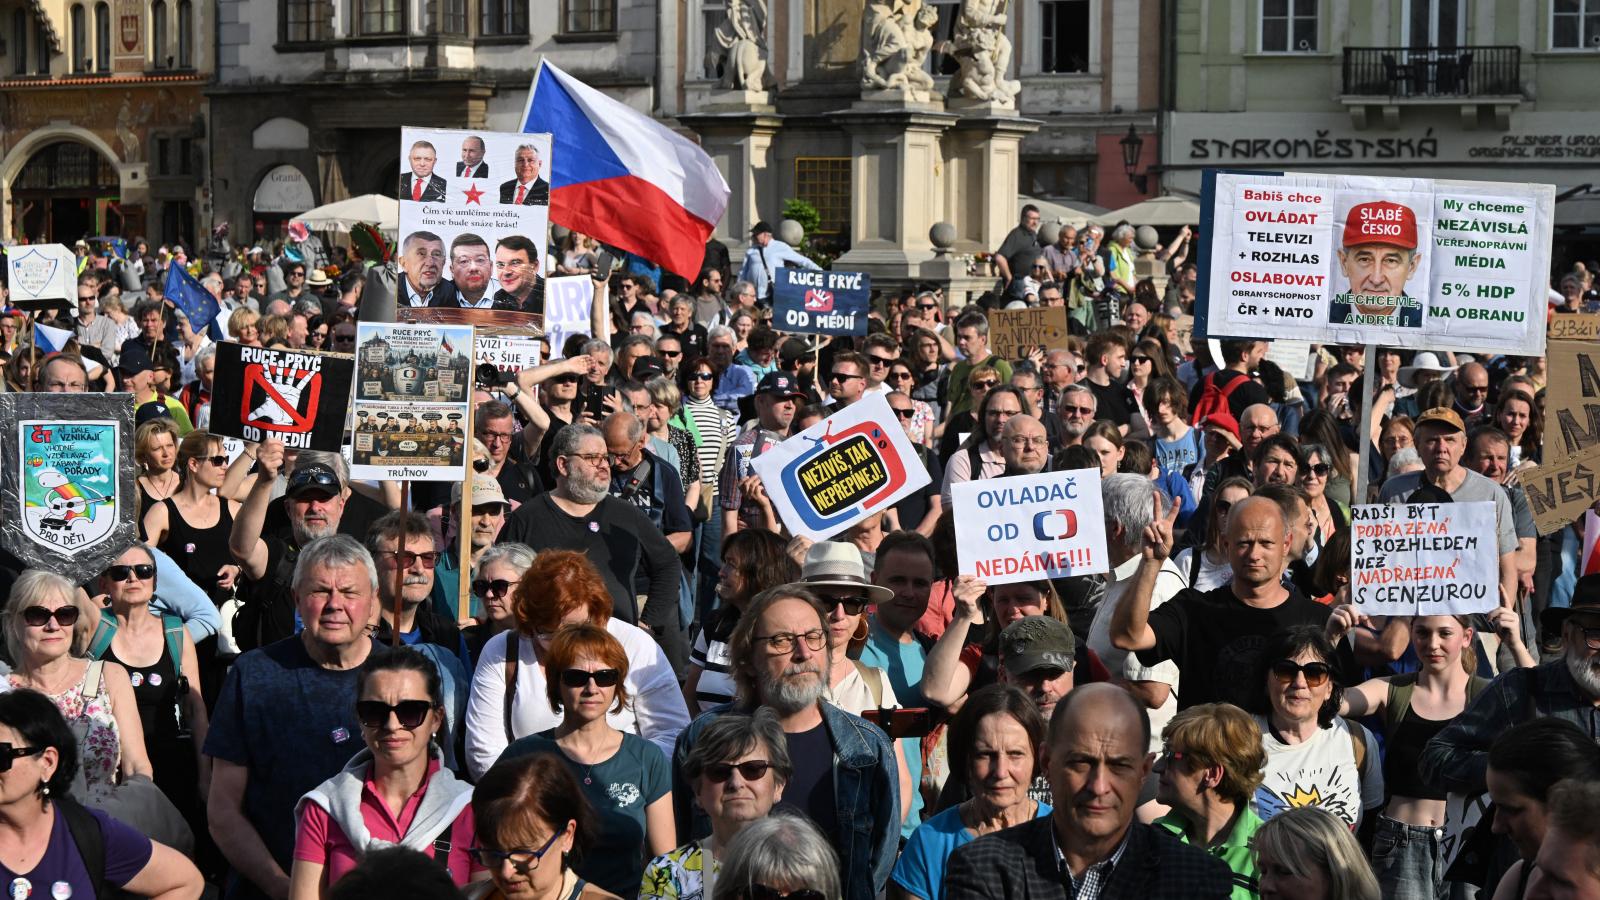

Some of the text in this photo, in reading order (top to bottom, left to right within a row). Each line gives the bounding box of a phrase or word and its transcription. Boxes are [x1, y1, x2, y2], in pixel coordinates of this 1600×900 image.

[1190, 127, 1438, 159] STAROMĚSTSKÁ
[1501, 135, 1562, 146] PILSNER
[1244, 189, 1322, 203] Babiš chce
[422, 205, 440, 215] Čím
[455, 208, 491, 217] umlčíme
[492, 209, 520, 219] média,
[1360, 206, 1403, 221] SLABÉ
[1443, 199, 1525, 213] My chceme
[448, 219, 469, 227] bude
[471, 220, 494, 228] snáze
[495, 220, 518, 228] krást!
[1245, 209, 1318, 225] OVLÁDAT
[1361, 221, 1401, 236] ČESKO
[1437, 218, 1528, 234] NEZÁVISLÁ
[1247, 231, 1313, 245] TELEVIZI
[1436, 237, 1527, 251] VEŘEJNOPRÁVNÍ
[1251, 251, 1320, 264] ROZHLAS
[1454, 254, 1506, 269] MÉDIA
[789, 270, 863, 290] RUCE PRYČ
[1230, 271, 1325, 287] OSLABOVAT
[1231, 289, 1321, 301] OBRANYSCHOPNOST
[1476, 285, 1515, 299] HDP
[1335, 293, 1420, 310] NECHCEME,
[1237, 302, 1257, 315] ČR
[1274, 306, 1313, 318] NATO
[1429, 306, 1525, 322] NA OBRANU
[786, 309, 857, 330] OD MÉDIÍ
[392, 329, 432, 337] RUCE PRYČ
[241, 346, 322, 372] RUCE PRYČ
[501, 350, 521, 363] ŠIJE
[32, 425, 53, 443] ČT
[60, 431, 104, 442] VZNIKAJÍ
[243, 426, 260, 441] OD
[845, 440, 872, 463] TAK
[64, 464, 102, 475] POŘADY
[388, 469, 428, 477] TRUTNOV
[813, 462, 885, 511] NEPŘEPÍNEJ!
[977, 477, 1078, 508] OVLADAČ
[1351, 503, 1440, 521] RADŠI BÝT
[39, 529, 86, 545] PRO DĚTI
[987, 523, 1019, 542] OD
[1355, 536, 1478, 555] S ROZHLEDEM
[975, 547, 1092, 578] NEDÁME!!!
[1354, 553, 1387, 570] NEŽ
[1354, 583, 1487, 604] S CENZUROU
